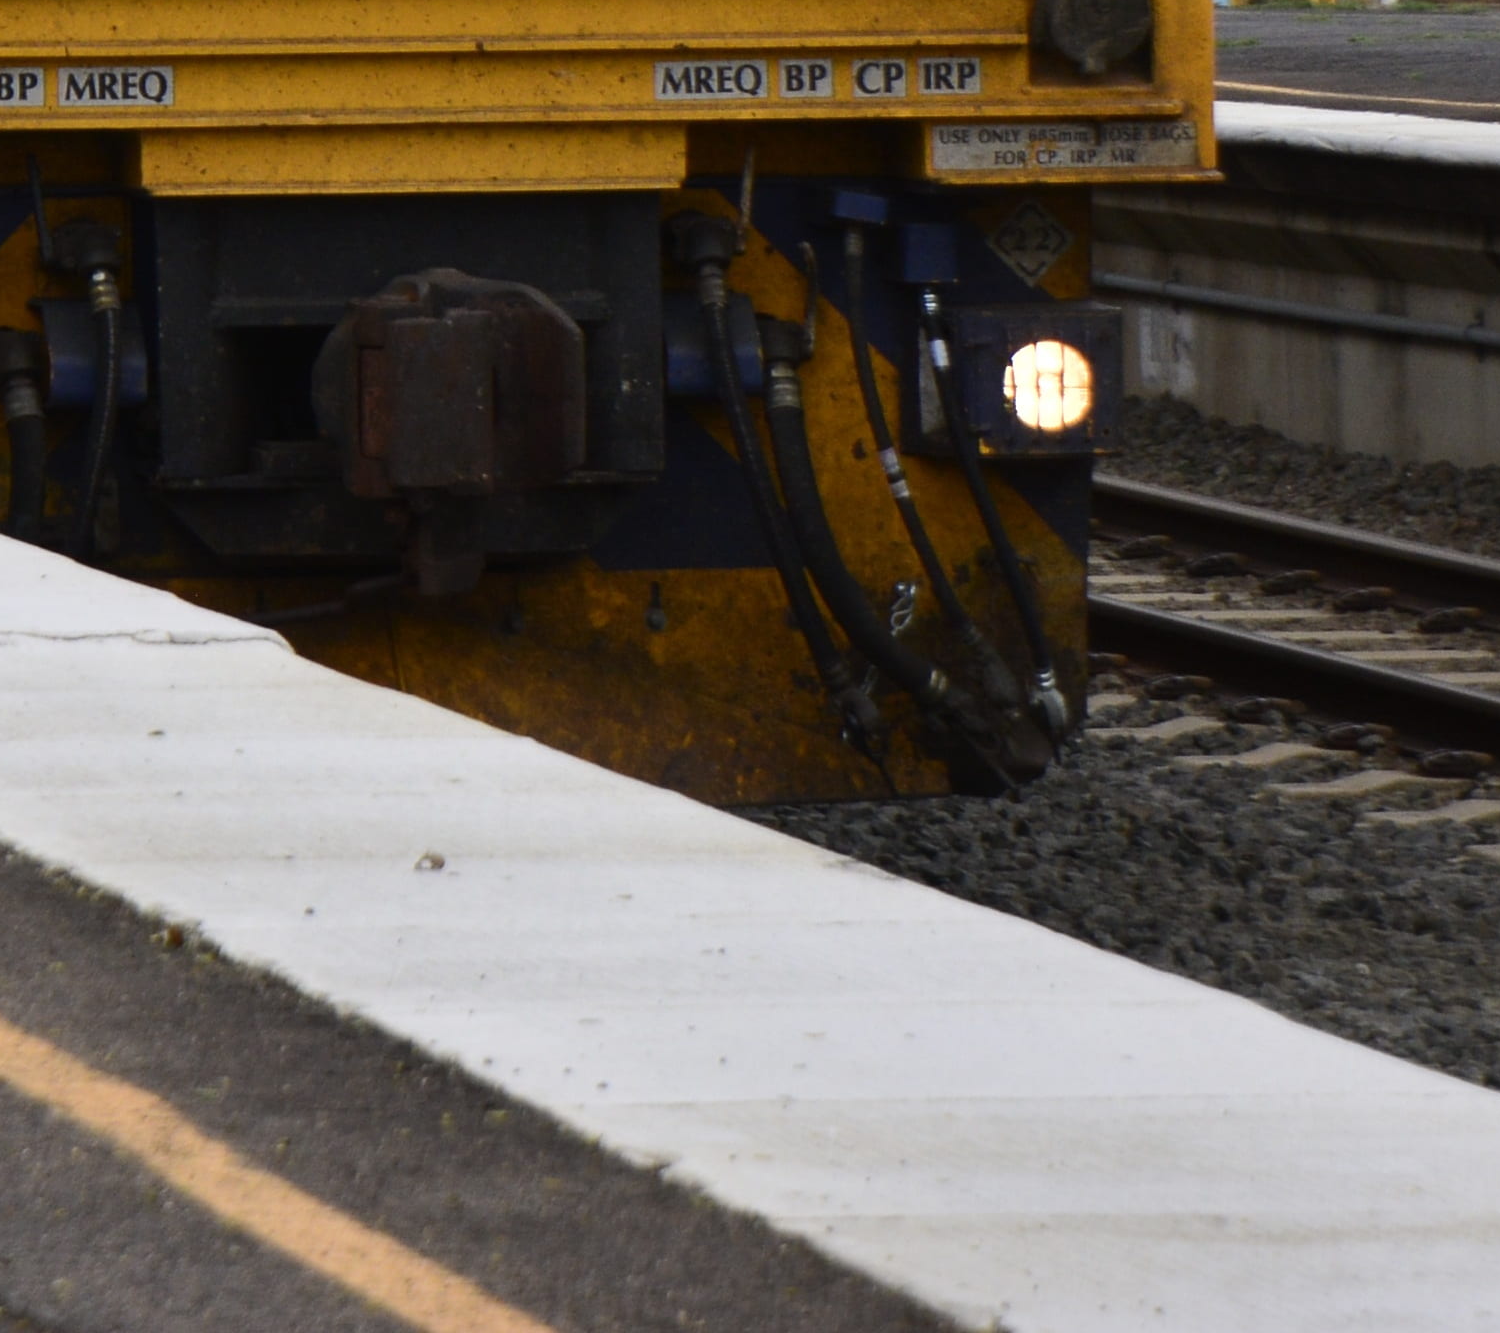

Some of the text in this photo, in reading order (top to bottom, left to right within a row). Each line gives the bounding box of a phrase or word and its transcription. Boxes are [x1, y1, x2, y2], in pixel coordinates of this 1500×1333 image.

[64, 69, 168, 103] MREQ
[661, 64, 762, 96] MREQ
[784, 63, 828, 92] BP
[856, 62, 904, 94] CP
[923, 61, 977, 90] IRP
[938, 129, 970, 144] USE
[978, 128, 1022, 143] ONLY
[994, 152, 1026, 165] FOR
[1112, 149, 1138, 163] MR
